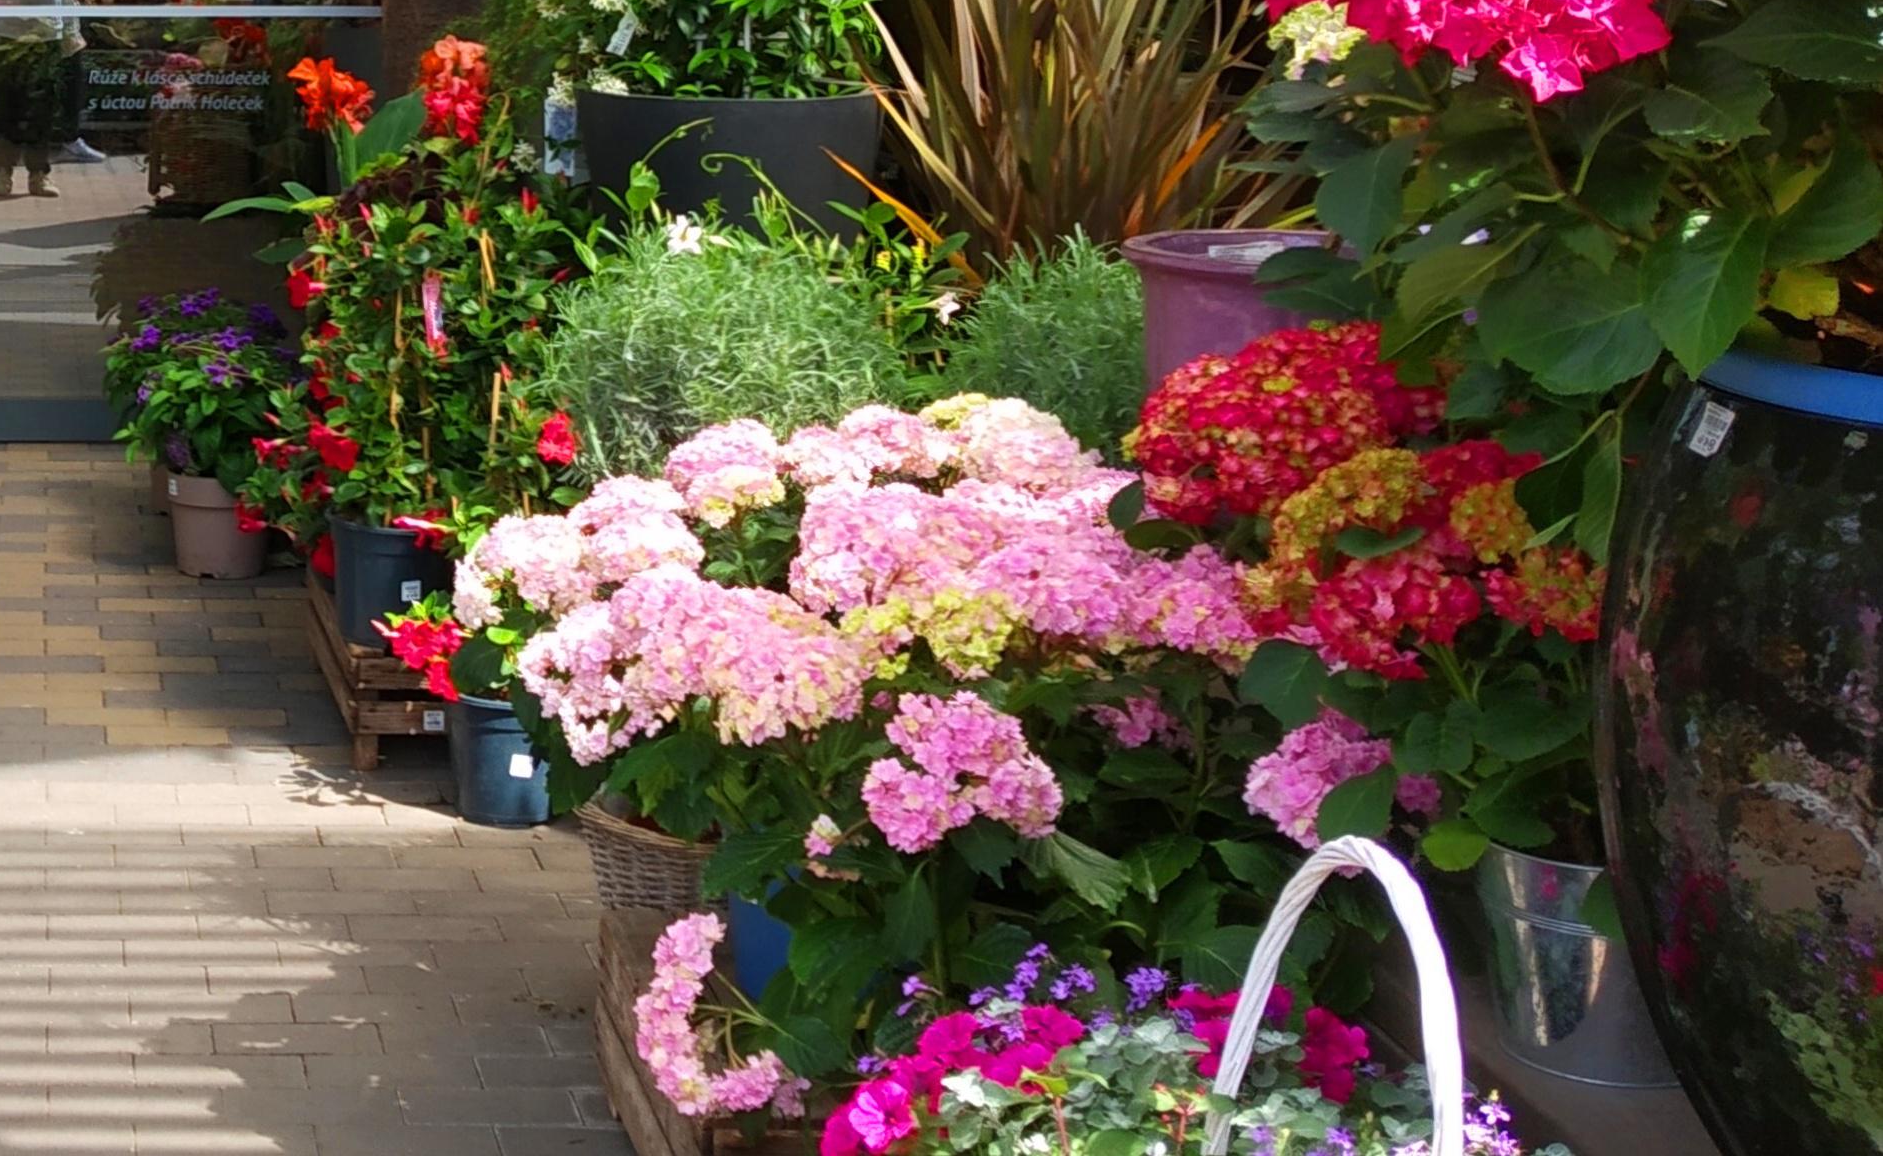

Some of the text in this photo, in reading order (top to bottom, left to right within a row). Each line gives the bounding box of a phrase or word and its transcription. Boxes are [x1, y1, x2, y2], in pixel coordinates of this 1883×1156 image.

[131, 69, 142, 85] k
[87, 97, 99, 110] s
[101, 95, 146, 110] úctou
[200, 95, 264, 111] Holeček
